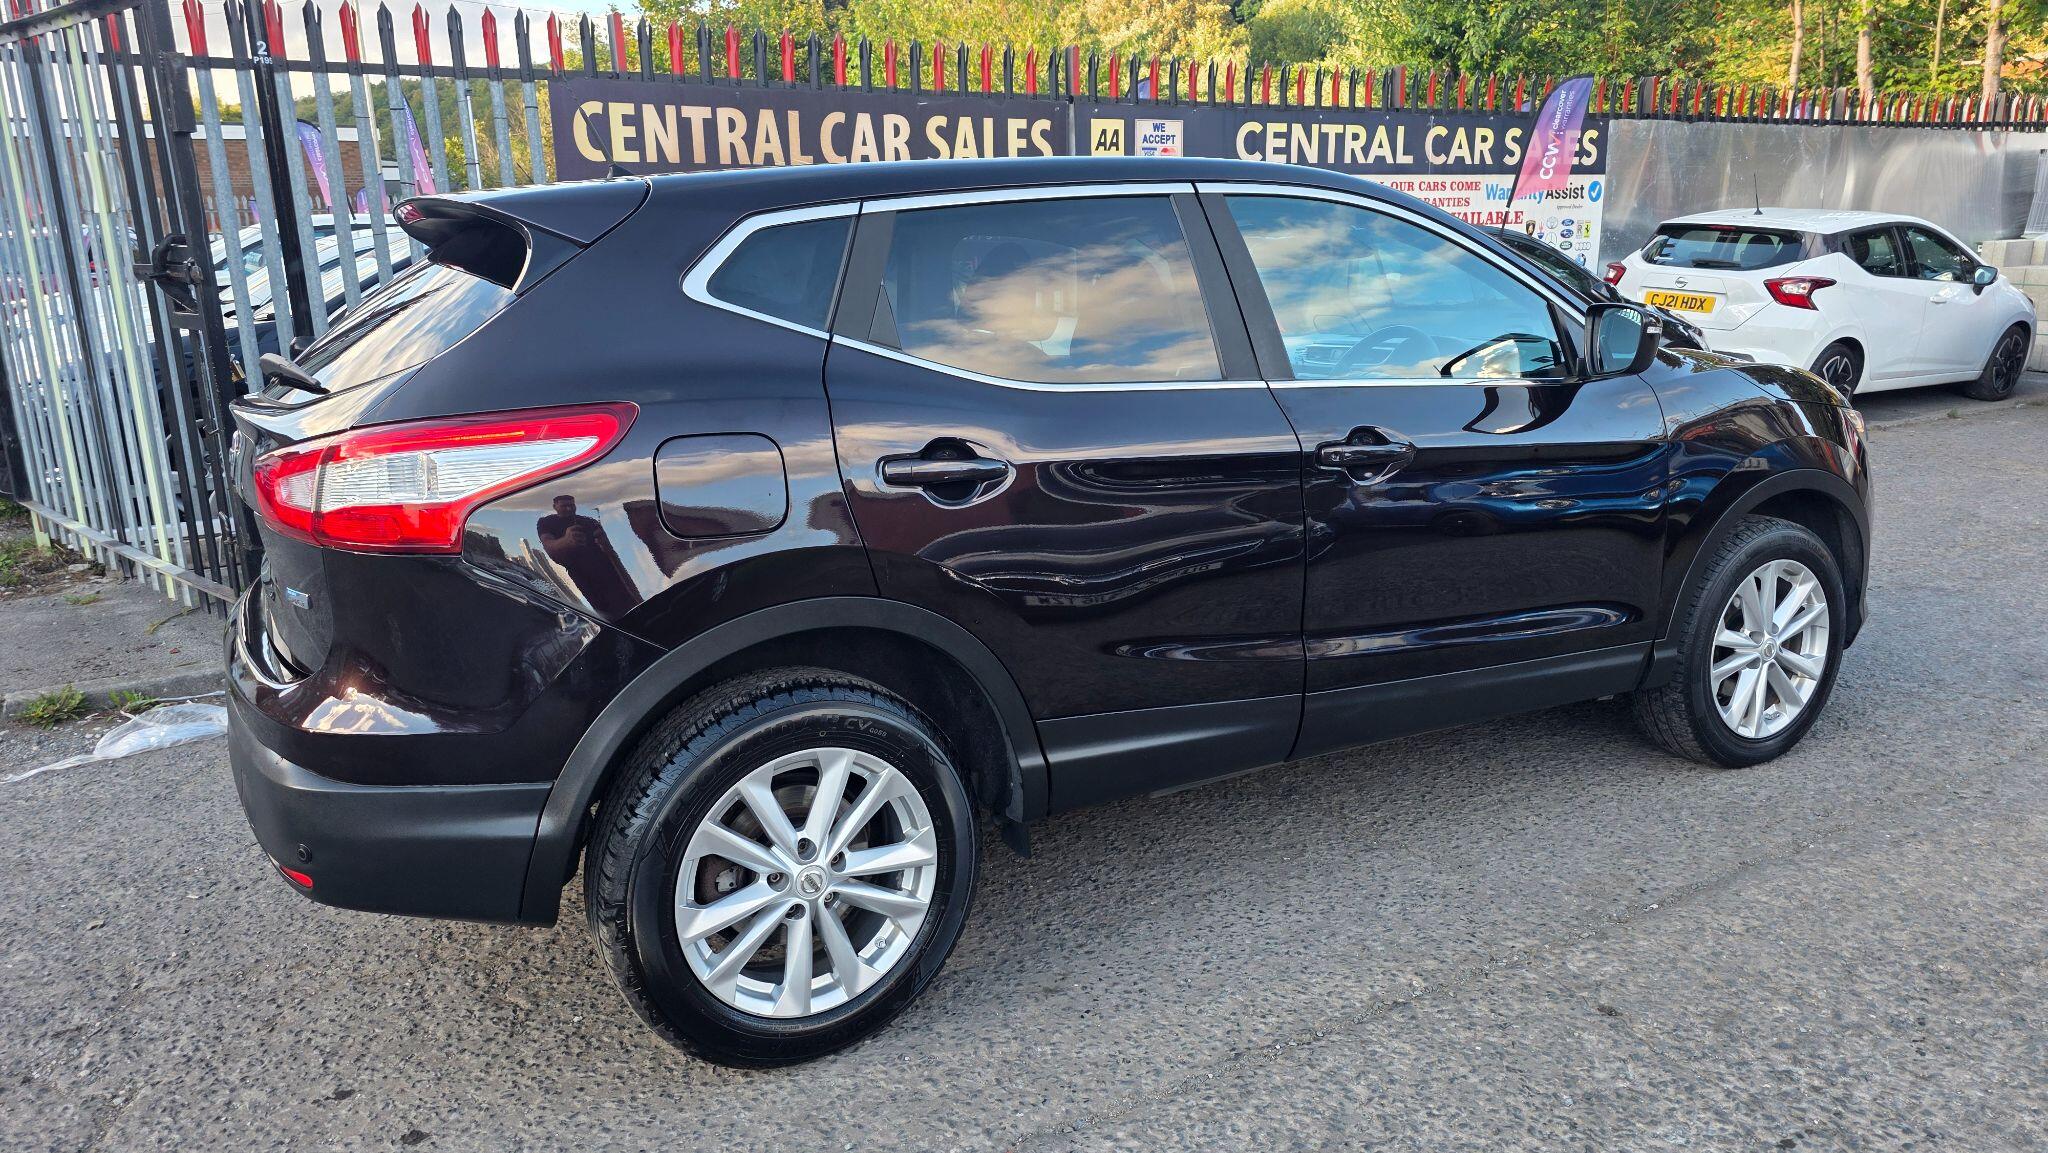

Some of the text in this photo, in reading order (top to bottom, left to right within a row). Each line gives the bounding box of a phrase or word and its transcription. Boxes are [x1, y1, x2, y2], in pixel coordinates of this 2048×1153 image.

[256, 41, 268, 55] 2
[1553, 89, 1567, 130] clearcover
[573, 100, 1055, 166] CENTRAL CAR SALES
[1152, 122, 1166, 133] WE
[1094, 128, 1120, 152] AA
[1142, 134, 1176, 145] ACCEPT
[1236, 121, 1600, 166] CENTRAL CAR SAES
[1390, 181, 1481, 192] OUR CARS COME
[1419, 197, 1471, 208] RANTIES
[1650, 293, 1707, 311] CJ21 HDX
